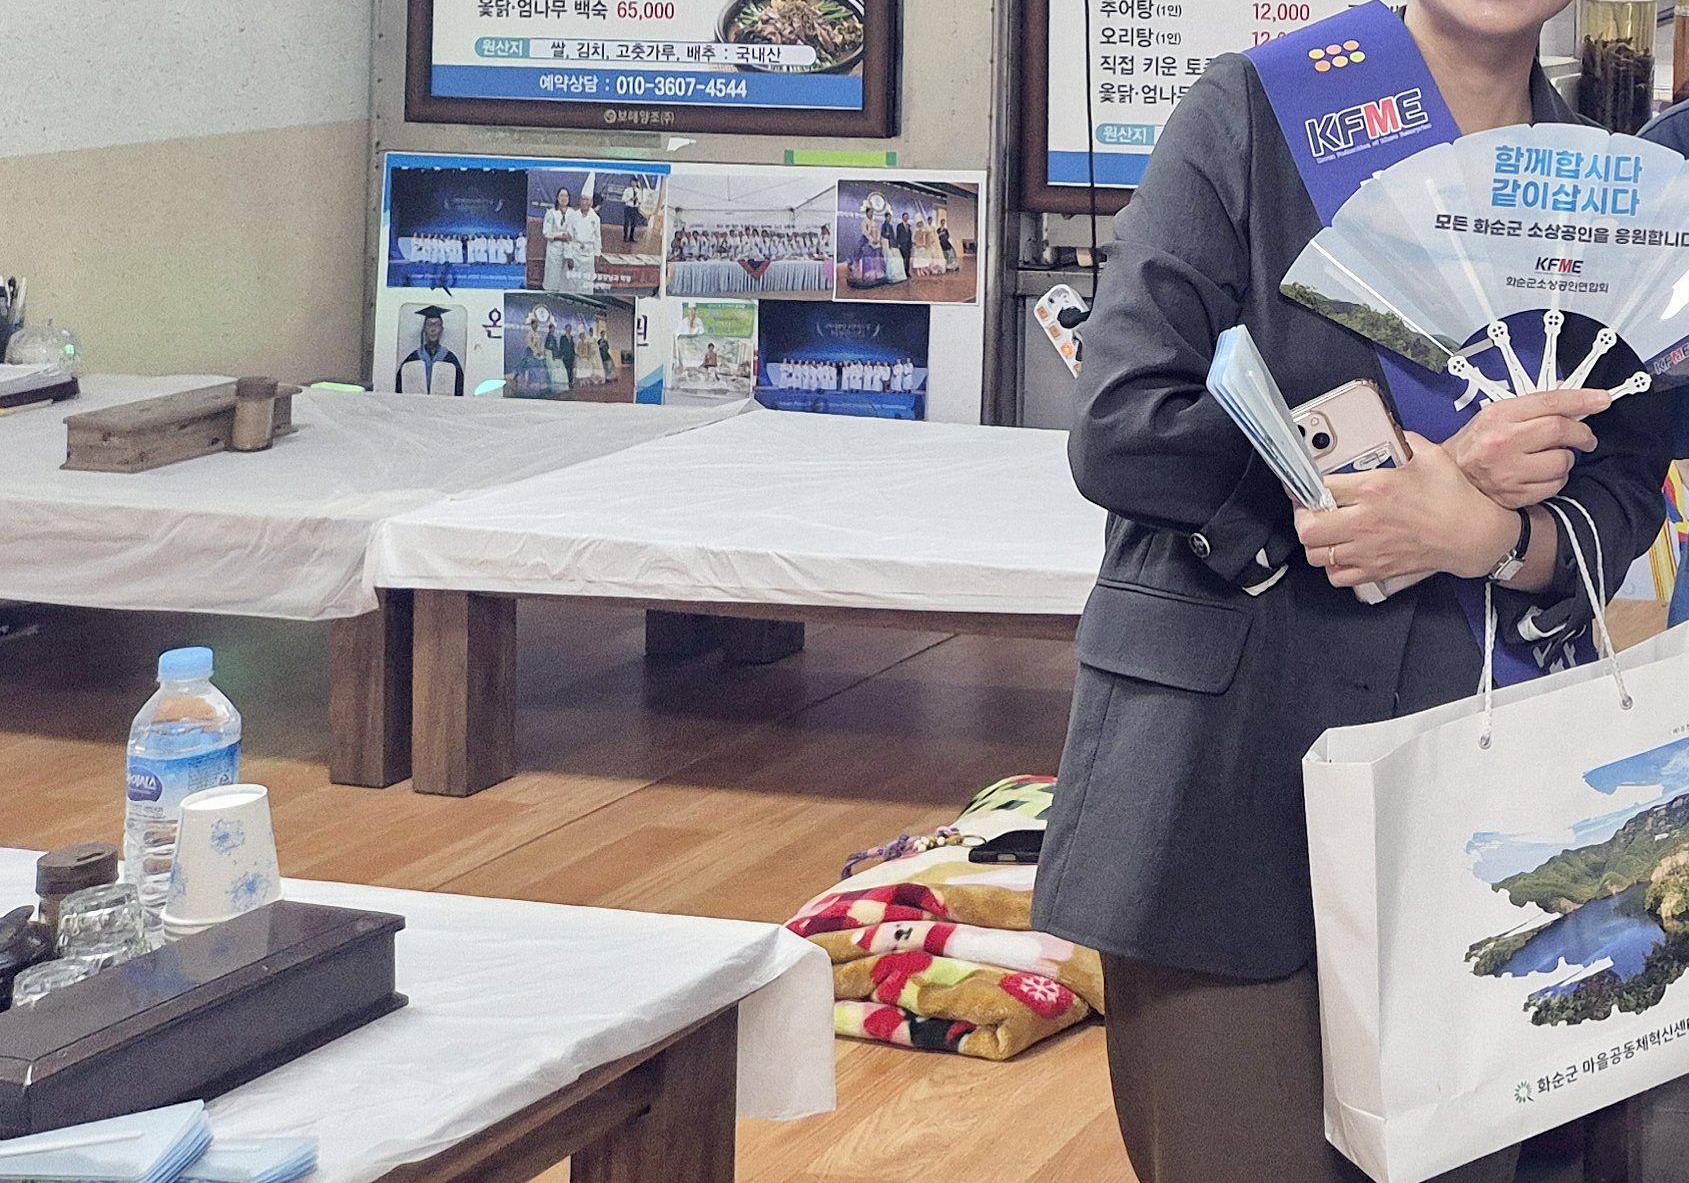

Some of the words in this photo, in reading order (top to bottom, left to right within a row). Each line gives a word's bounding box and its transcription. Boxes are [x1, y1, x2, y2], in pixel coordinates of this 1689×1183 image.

[574, 0, 608, 21] 백숙
[616, 1, 675, 22] 65,000
[1252, 3, 1310, 23] 12,000
[481, 38, 523, 57] 원산지
[687, 44, 717, 63] 배추
[736, 46, 782, 65] 국내산
[1100, 55, 1134, 75] 직접
[1143, 56, 1177, 76] 키운
[539, 74, 598, 95] 예약상담
[616, 78, 747, 98] 010-3607-4544
[1103, 125, 1147, 143] 원산지
[1304, 87, 1429, 158] KFME
[1494, 145, 1643, 184] 함께합시다
[1490, 178, 1641, 216] 같이삽시다
[1434, 213, 1469, 232] 모든
[1473, 218, 1523, 237] 화순군
[1527, 222, 1610, 244] 소상공인을
[1535, 256, 1584, 274] KFME
[1506, 275, 1609, 294] 화순군소상공인연합회
[1537, 1066, 1579, 1096] 화순군
